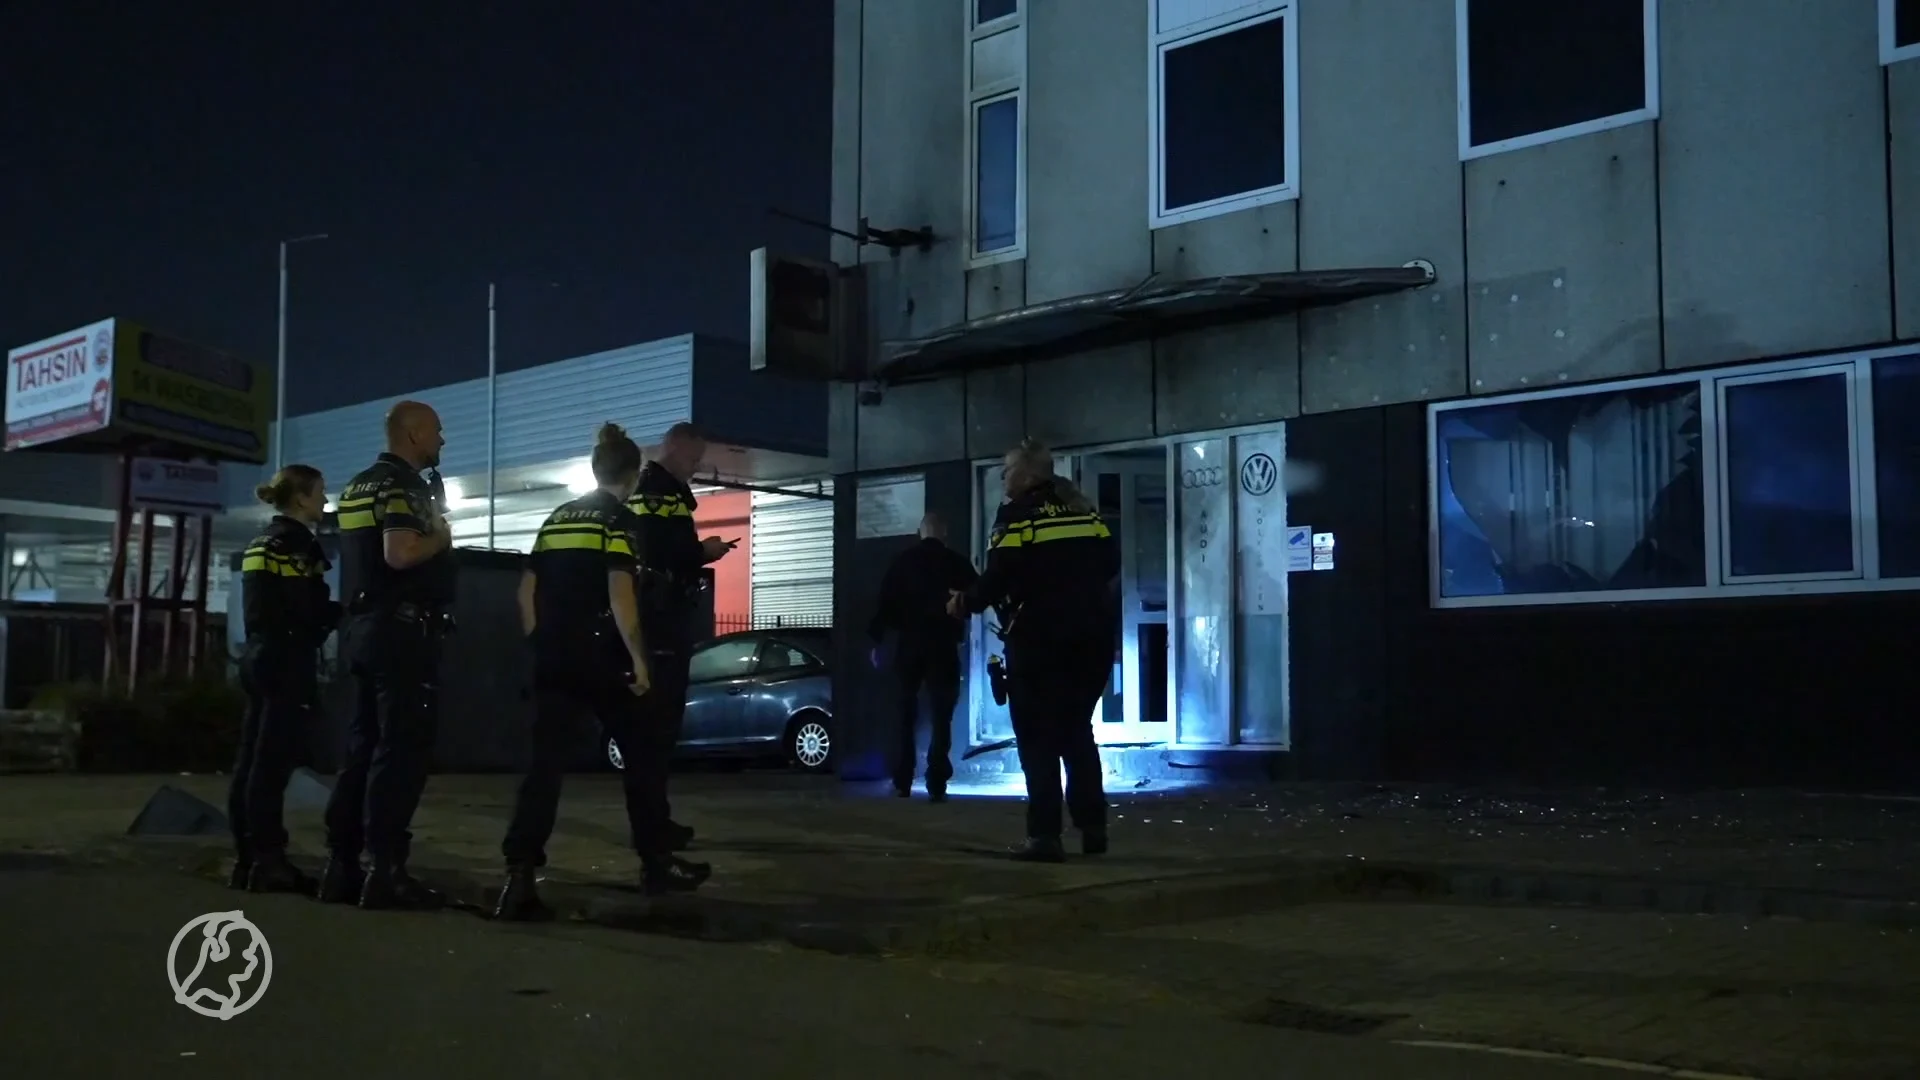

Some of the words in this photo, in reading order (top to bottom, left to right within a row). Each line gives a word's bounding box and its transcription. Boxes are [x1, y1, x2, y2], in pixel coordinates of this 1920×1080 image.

[11, 335, 88, 393] TAHSIN
[1199, 509, 1208, 564] AUDI
[1256, 508, 1265, 611] VOLKEN
